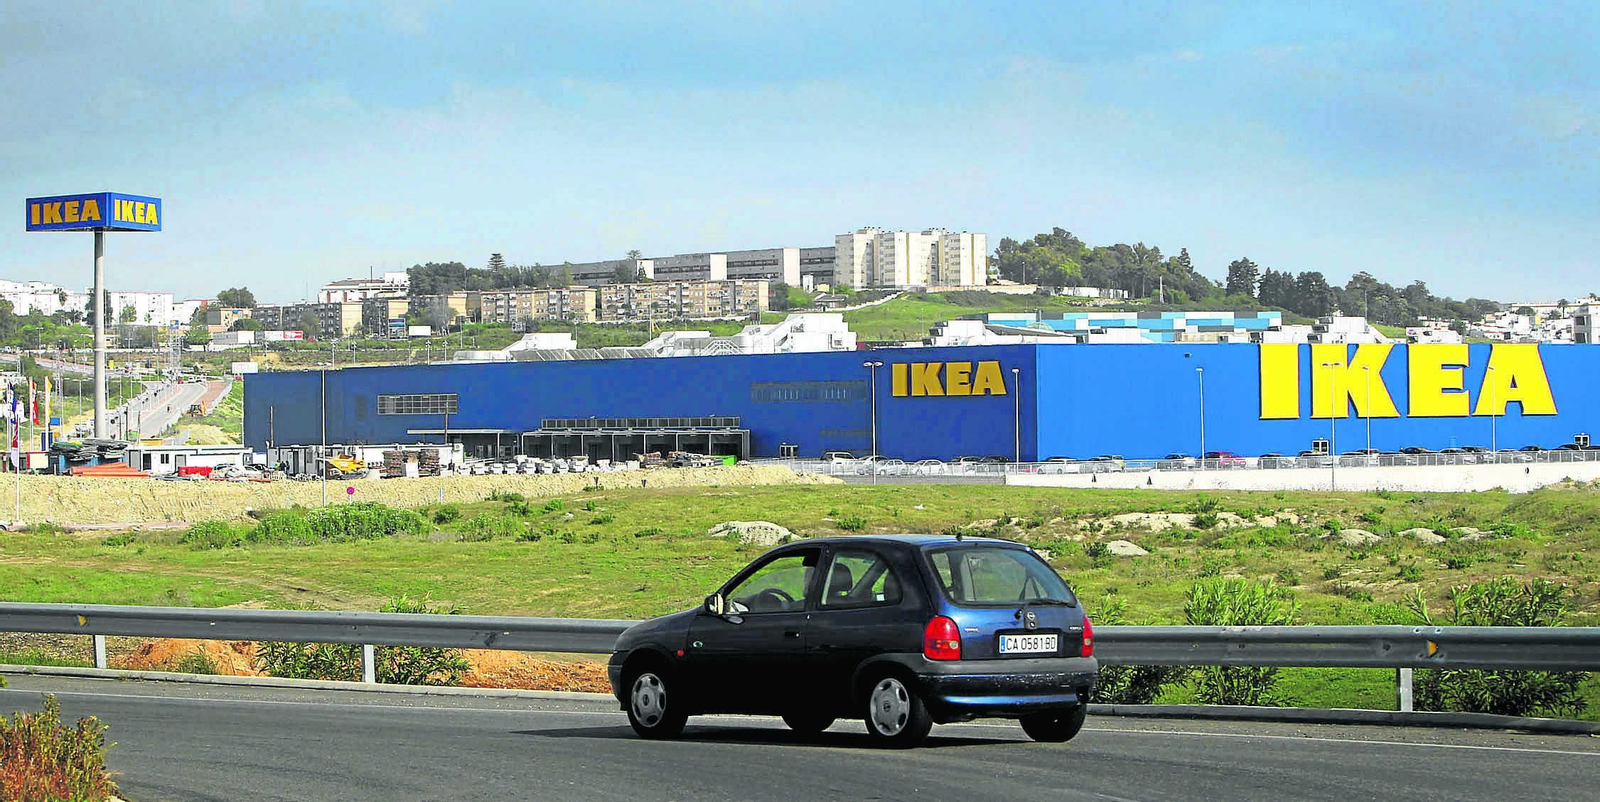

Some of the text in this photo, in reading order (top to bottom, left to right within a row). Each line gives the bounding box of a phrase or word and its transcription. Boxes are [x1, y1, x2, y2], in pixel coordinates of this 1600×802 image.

[31, 199, 101, 225] IKEA
[113, 199, 158, 225] IKEA
[891, 360, 1007, 397] IKEA
[1259, 343, 1558, 419] IKEA
[1006, 637, 1018, 650] CA
[1020, 637, 1043, 650] 0581
